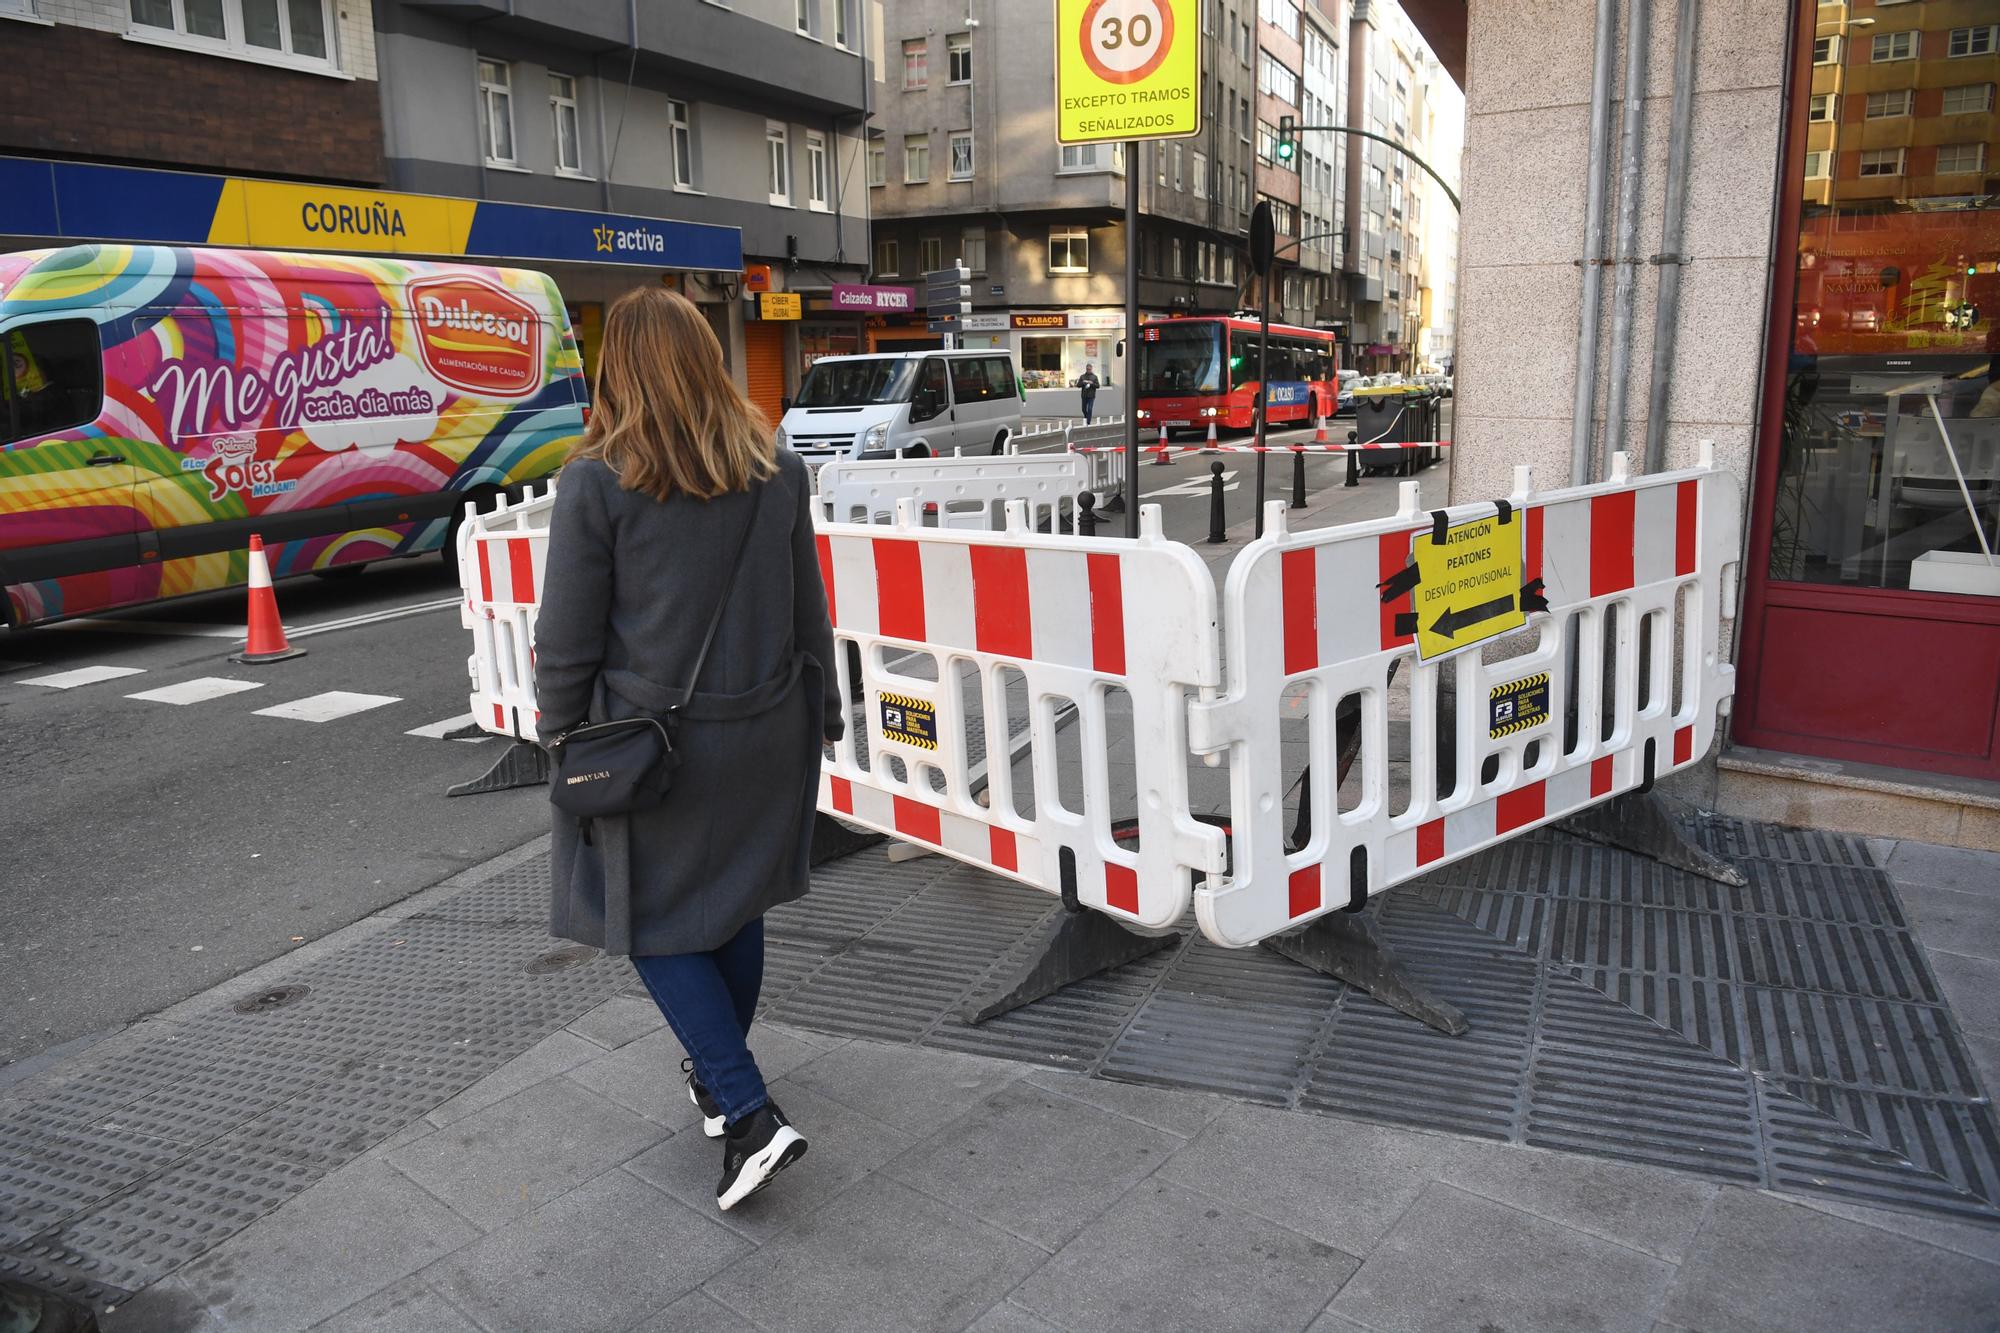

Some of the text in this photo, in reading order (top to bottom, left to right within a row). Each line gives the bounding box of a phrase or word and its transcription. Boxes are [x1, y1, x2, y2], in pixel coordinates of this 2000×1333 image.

[1101, 14, 1152, 50] 30
[1064, 87, 1190, 110] EXCEPTO TRAMOS
[1079, 113, 1175, 133] SEÑALIZADOS
[302, 201, 406, 237] CORUÑA
[617, 227, 664, 252] activa
[840, 291, 873, 305] Calzados
[420, 296, 529, 346] Dulcesol
[152, 306, 391, 445] Me gusta!
[438, 357, 526, 379] ALIMENTACIÓN DE CALIDAD
[305, 388, 430, 418] cada día más
[213, 439, 256, 454] Dulcesol
[204, 456, 272, 499] Soles
[1447, 522, 1491, 545] ATENCIÓN
[1447, 547, 1491, 570] PEATONES
[1424, 565, 1512, 602] DESVÍO PROVISIONAL
[1496, 701, 1513, 717] F3
